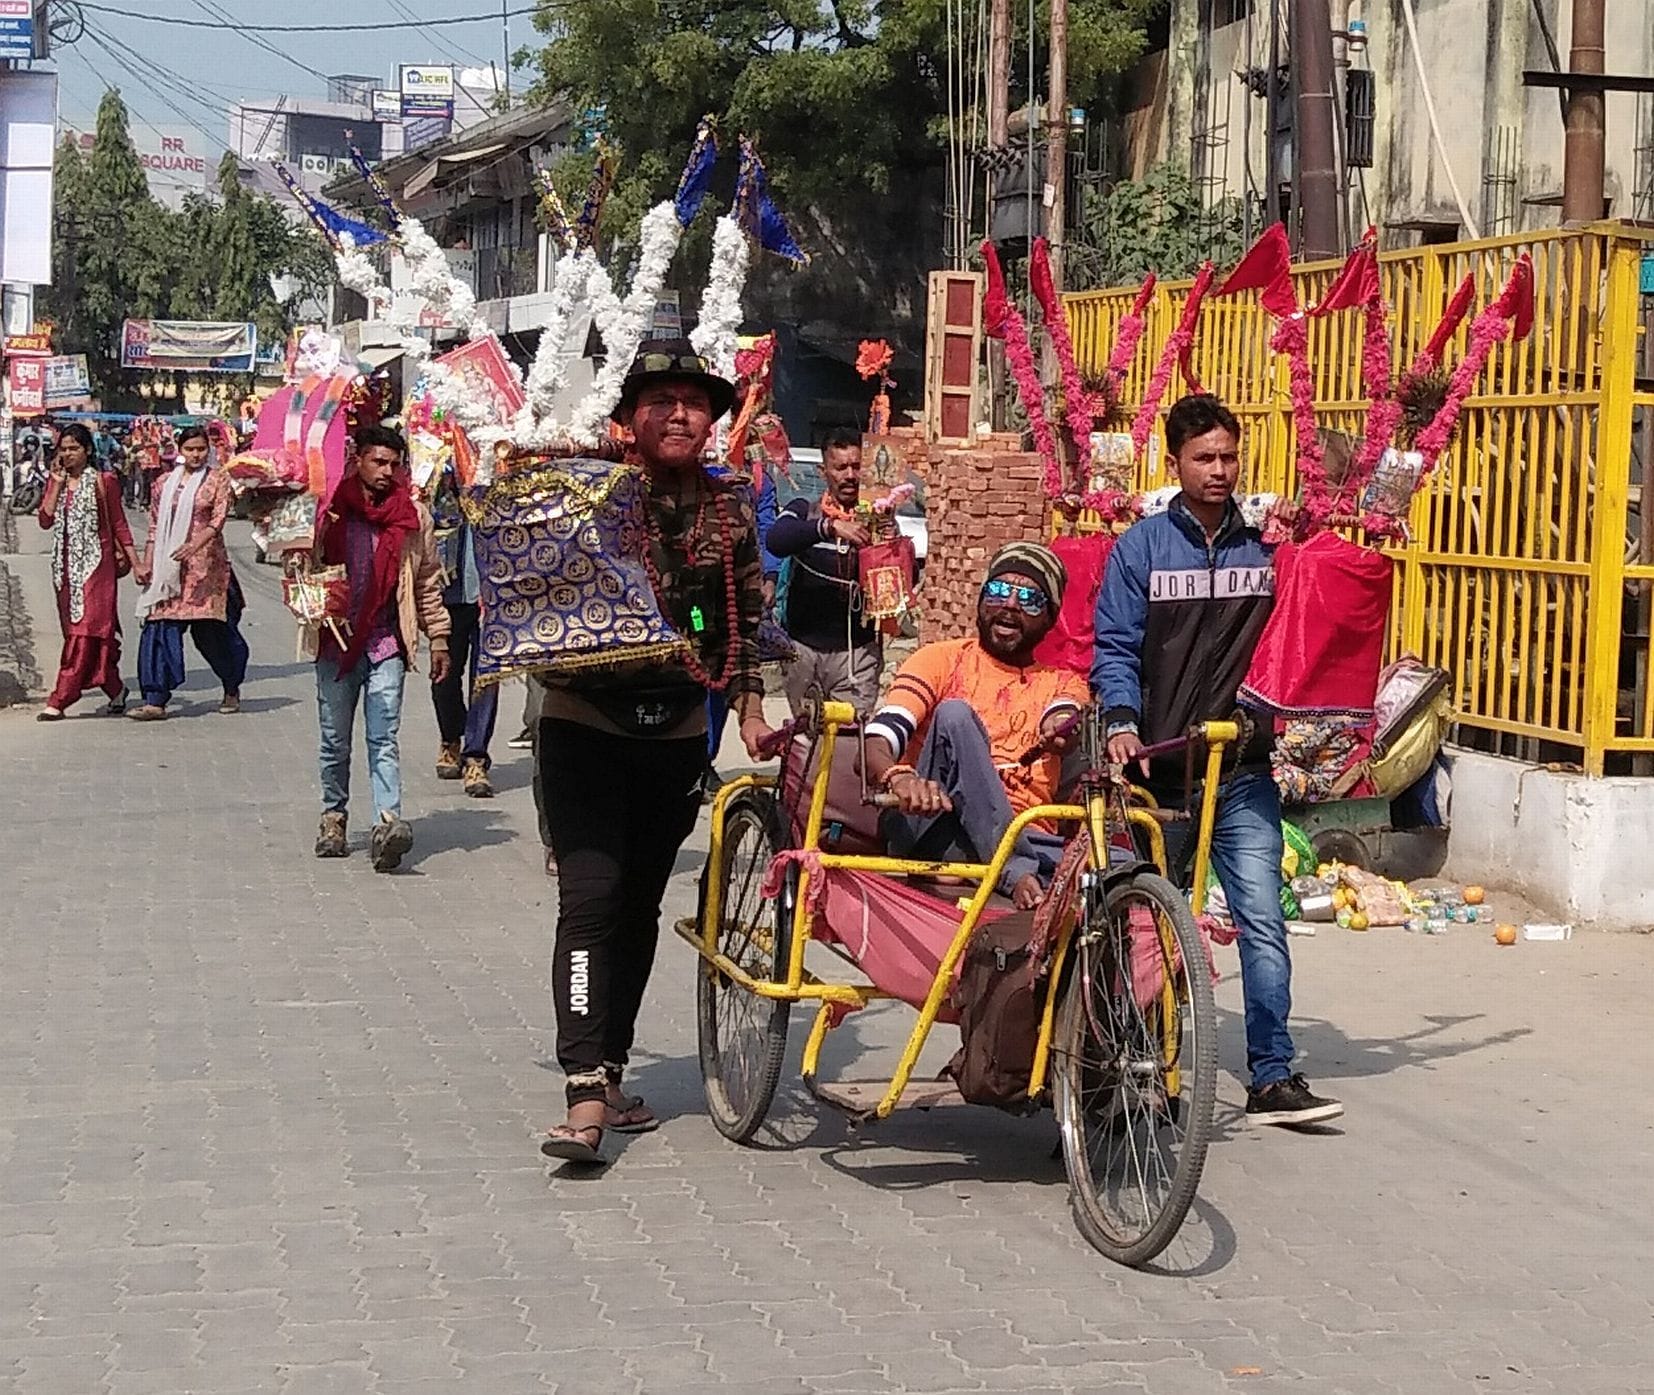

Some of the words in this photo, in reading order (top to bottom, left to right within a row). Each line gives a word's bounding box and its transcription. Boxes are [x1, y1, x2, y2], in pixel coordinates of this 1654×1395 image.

[161, 137, 185, 153] RR
[141, 154, 204, 172] SQUARE
[570, 950, 589, 1016] JORDAN
